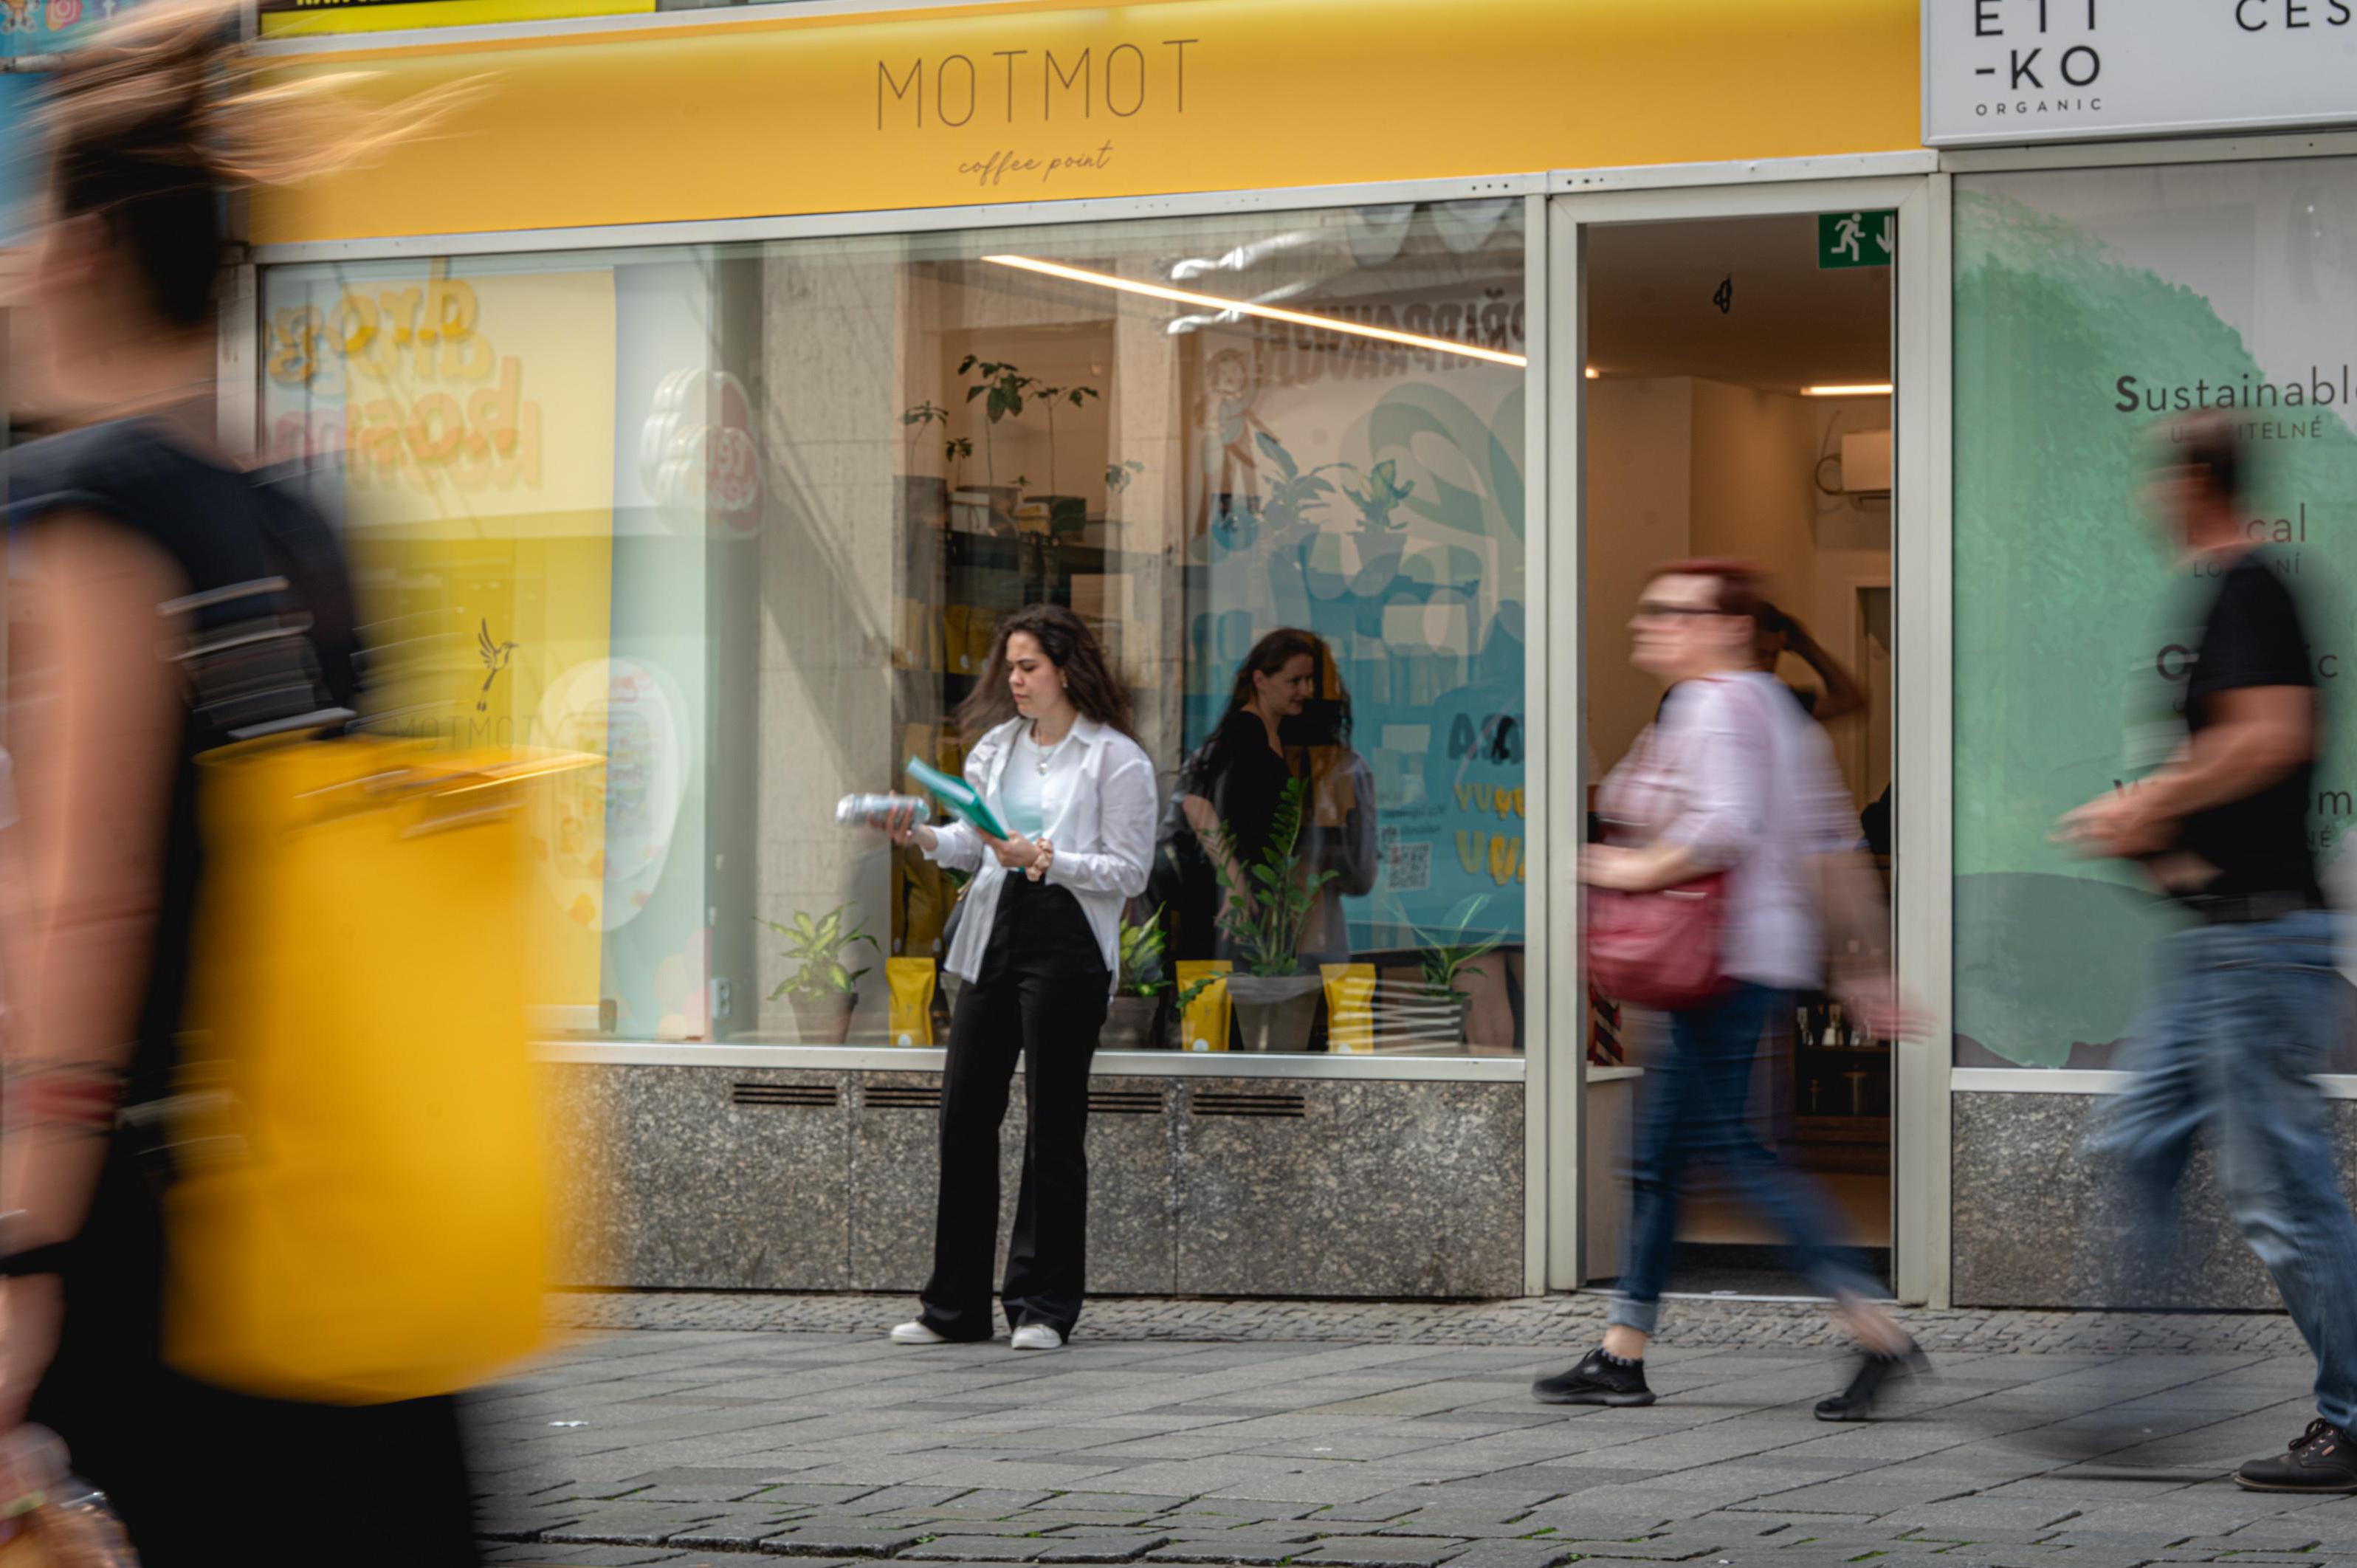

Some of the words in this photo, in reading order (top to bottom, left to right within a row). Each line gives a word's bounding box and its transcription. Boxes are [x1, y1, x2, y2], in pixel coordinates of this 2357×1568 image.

[877, 39, 1200, 130] MOTMOT
[1975, 98, 2102, 117] ORGANIC
[958, 150, 1042, 187] coffee
[1042, 139, 1113, 182] point
[2114, 364, 2357, 413] Sustainabl
[2170, 415, 2323, 444] UITELNÉ
[393, 713, 539, 751] MOTMOT
